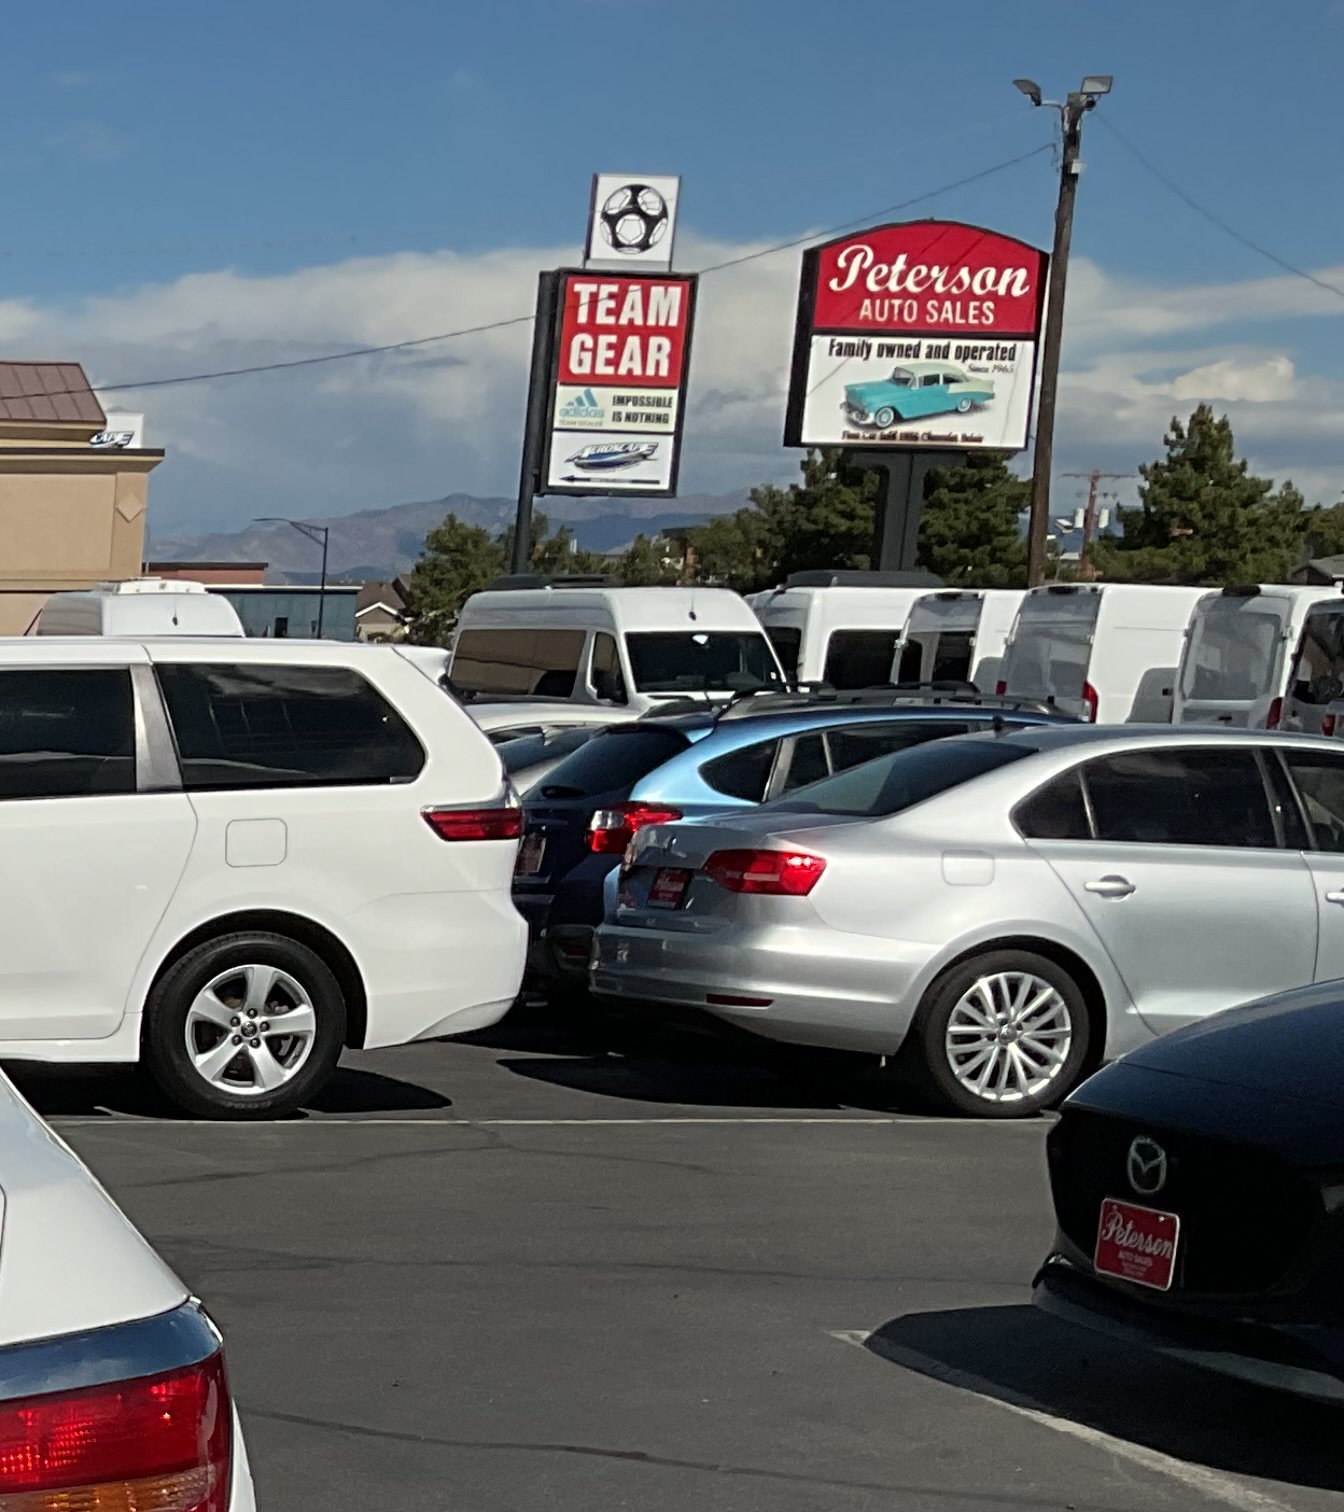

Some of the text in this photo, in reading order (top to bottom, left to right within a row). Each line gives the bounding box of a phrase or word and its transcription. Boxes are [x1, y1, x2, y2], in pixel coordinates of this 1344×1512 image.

[828, 243, 1030, 297] Peterson
[573, 283, 682, 327] TEAM
[859, 299, 995, 325] AUTO SALES
[569, 332, 671, 377] GEAR
[828, 338, 1017, 364] Family owned and operated
[559, 406, 605, 418] adidas
[612, 395, 673, 409] IMPOSSIBLE
[612, 412, 670, 425] IS NOTHING
[1101, 1210, 1174, 1260] Peterson
